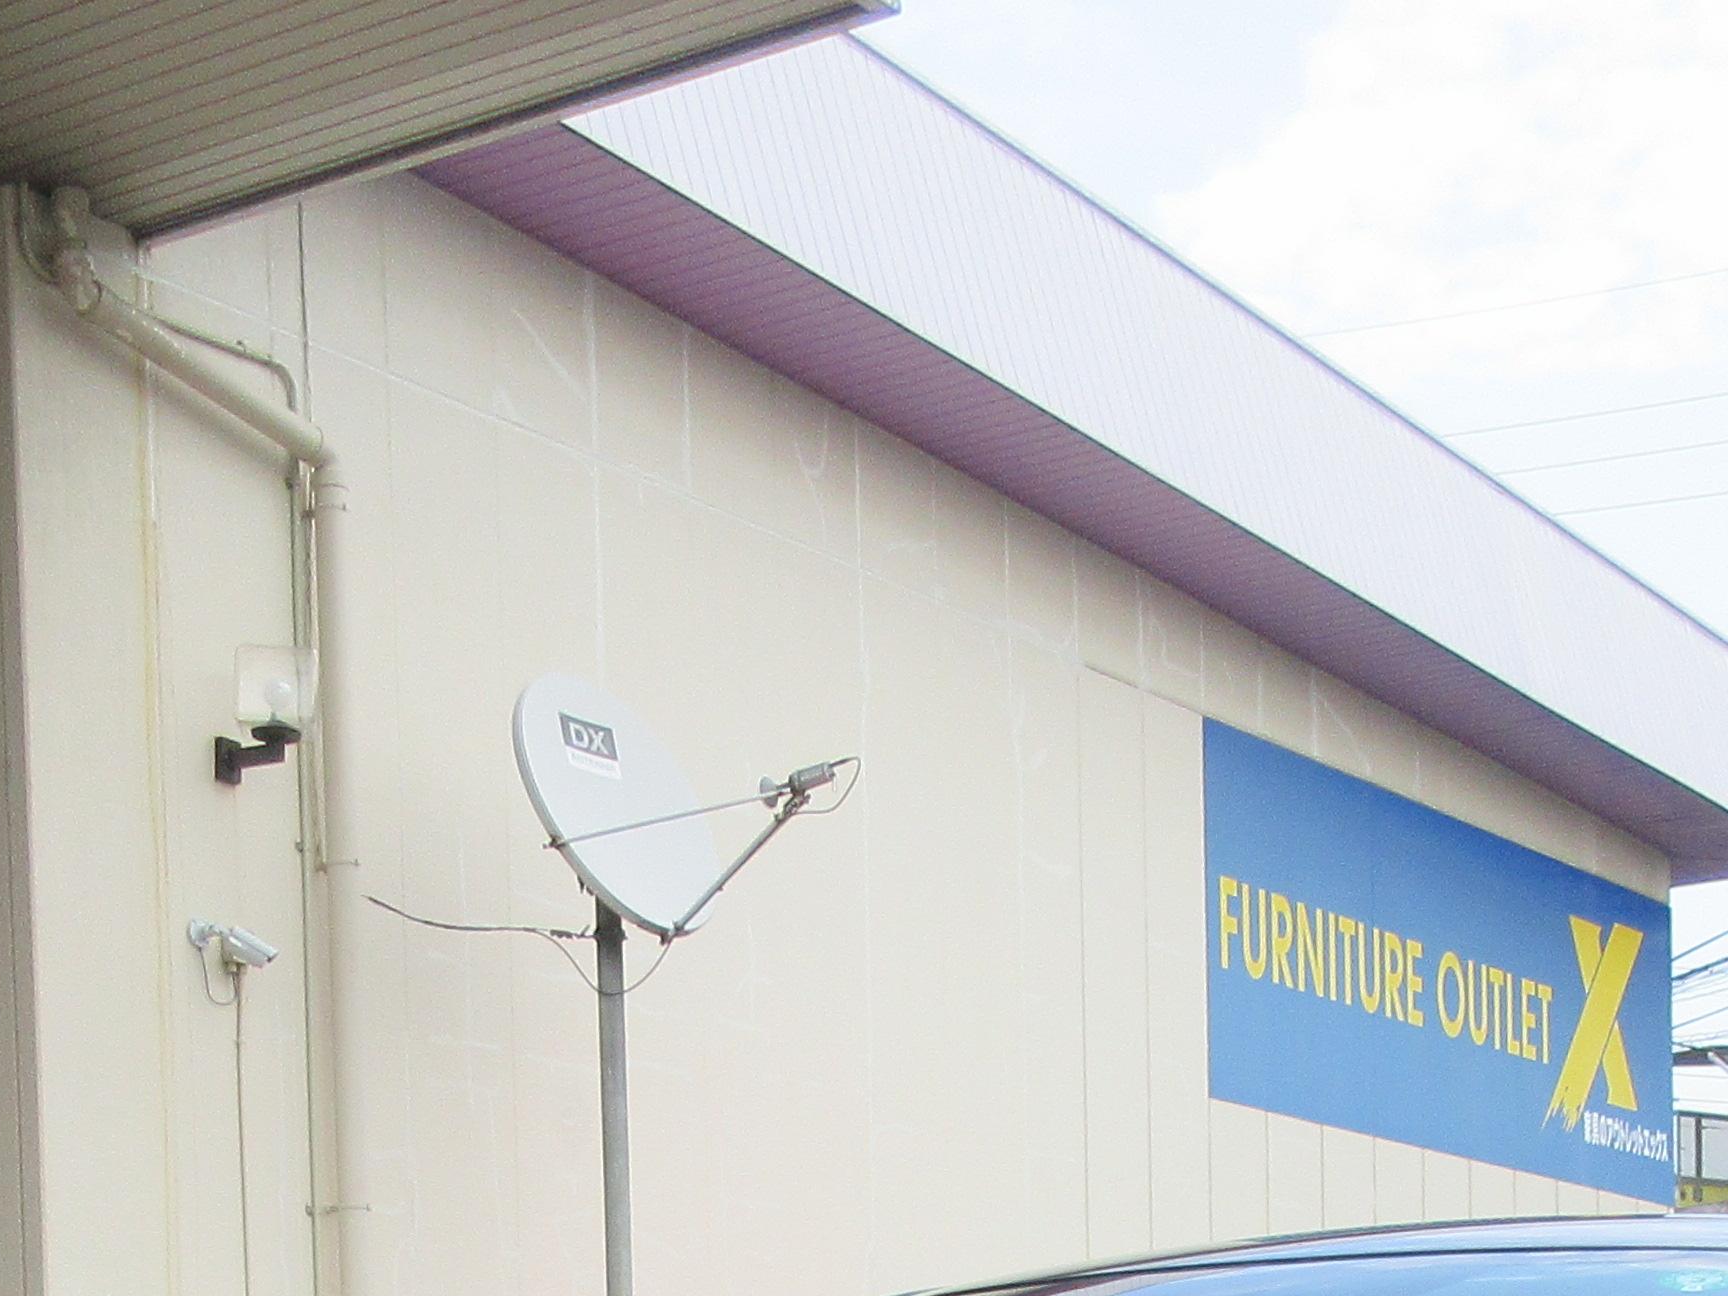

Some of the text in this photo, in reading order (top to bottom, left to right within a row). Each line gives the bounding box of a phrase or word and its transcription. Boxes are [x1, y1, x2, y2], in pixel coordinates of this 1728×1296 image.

[569, 721, 609, 755] DX
[1218, 876, 1425, 1027] FURNITURE
[1436, 951, 1554, 1064] OUTLET
